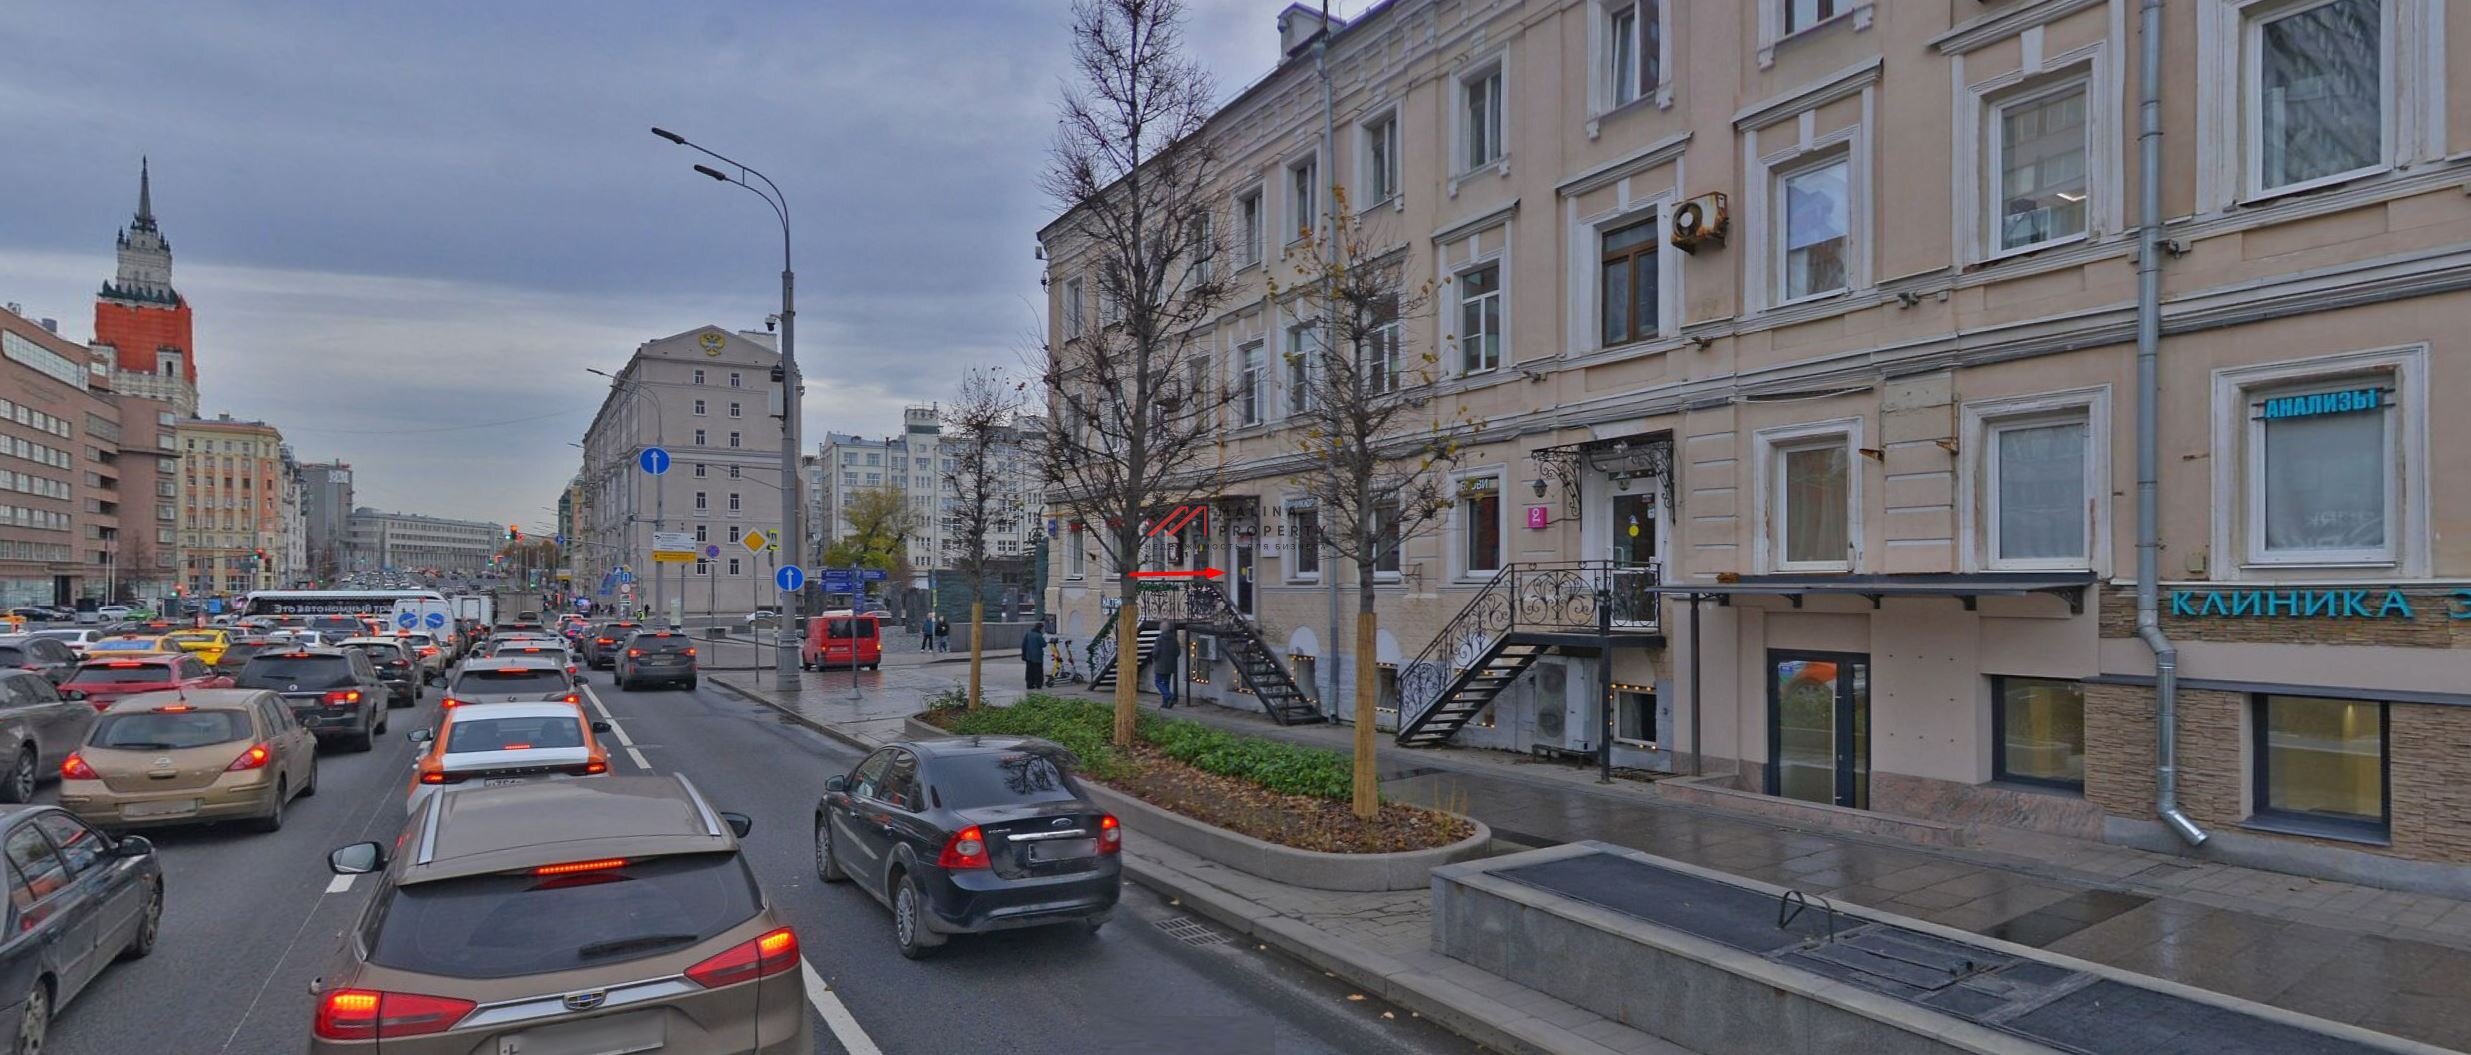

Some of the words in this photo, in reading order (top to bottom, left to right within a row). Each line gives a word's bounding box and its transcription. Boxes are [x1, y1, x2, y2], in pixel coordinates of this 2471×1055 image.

[2266, 389, 2378, 419] АНАЛИЗЫ
[273, 604, 296, 613] Это
[297, 603, 372, 613] автономный
[2171, 588, 2414, 618] КЛИНИКА
